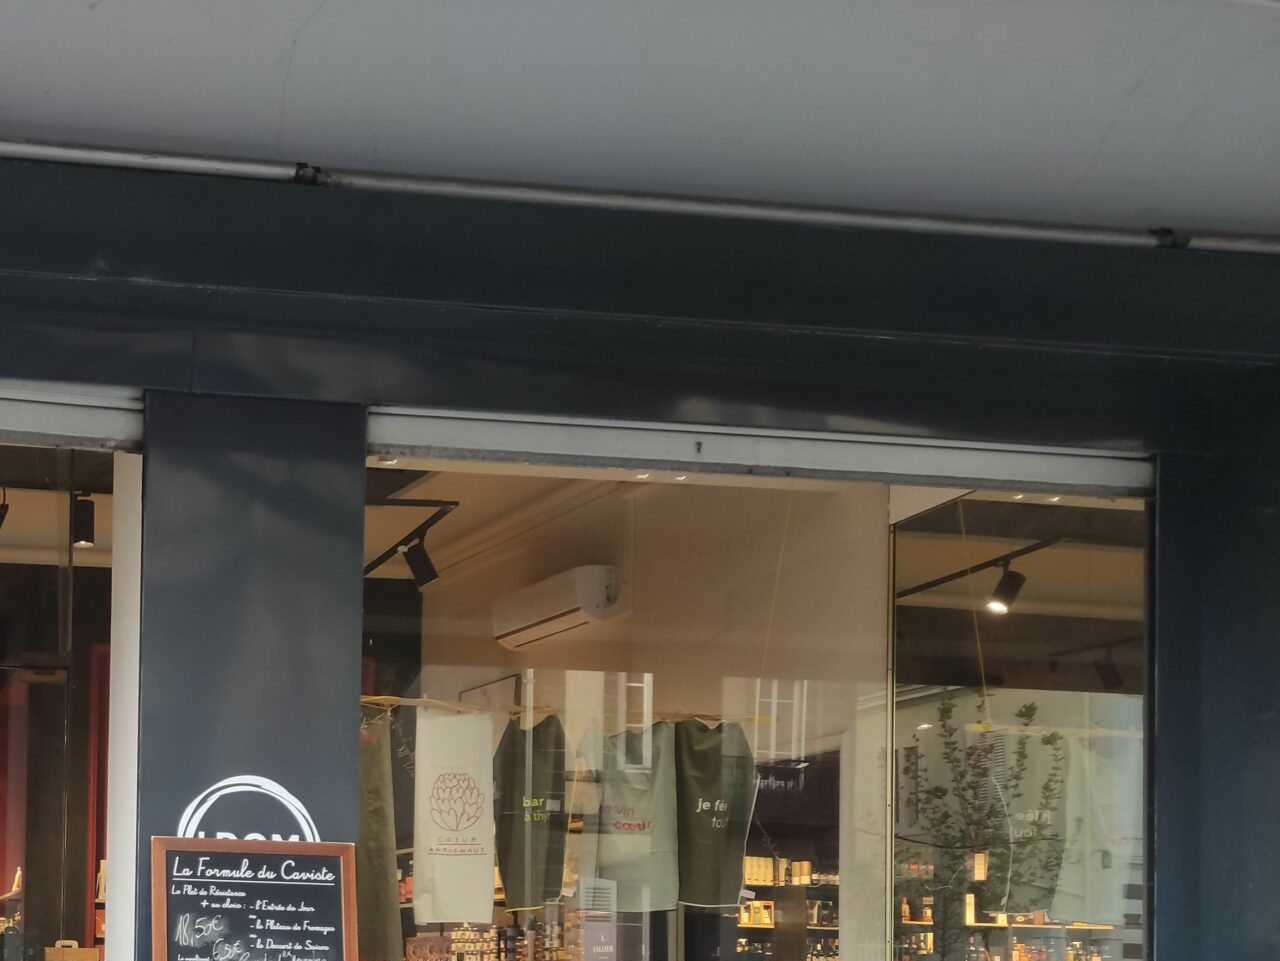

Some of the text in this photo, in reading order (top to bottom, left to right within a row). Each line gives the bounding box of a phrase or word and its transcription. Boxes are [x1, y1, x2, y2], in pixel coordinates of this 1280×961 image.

[522, 796, 544, 807] bar
[173, 856, 335, 881] La Formule du Caviste
[183, 884, 198, 895] Plat
